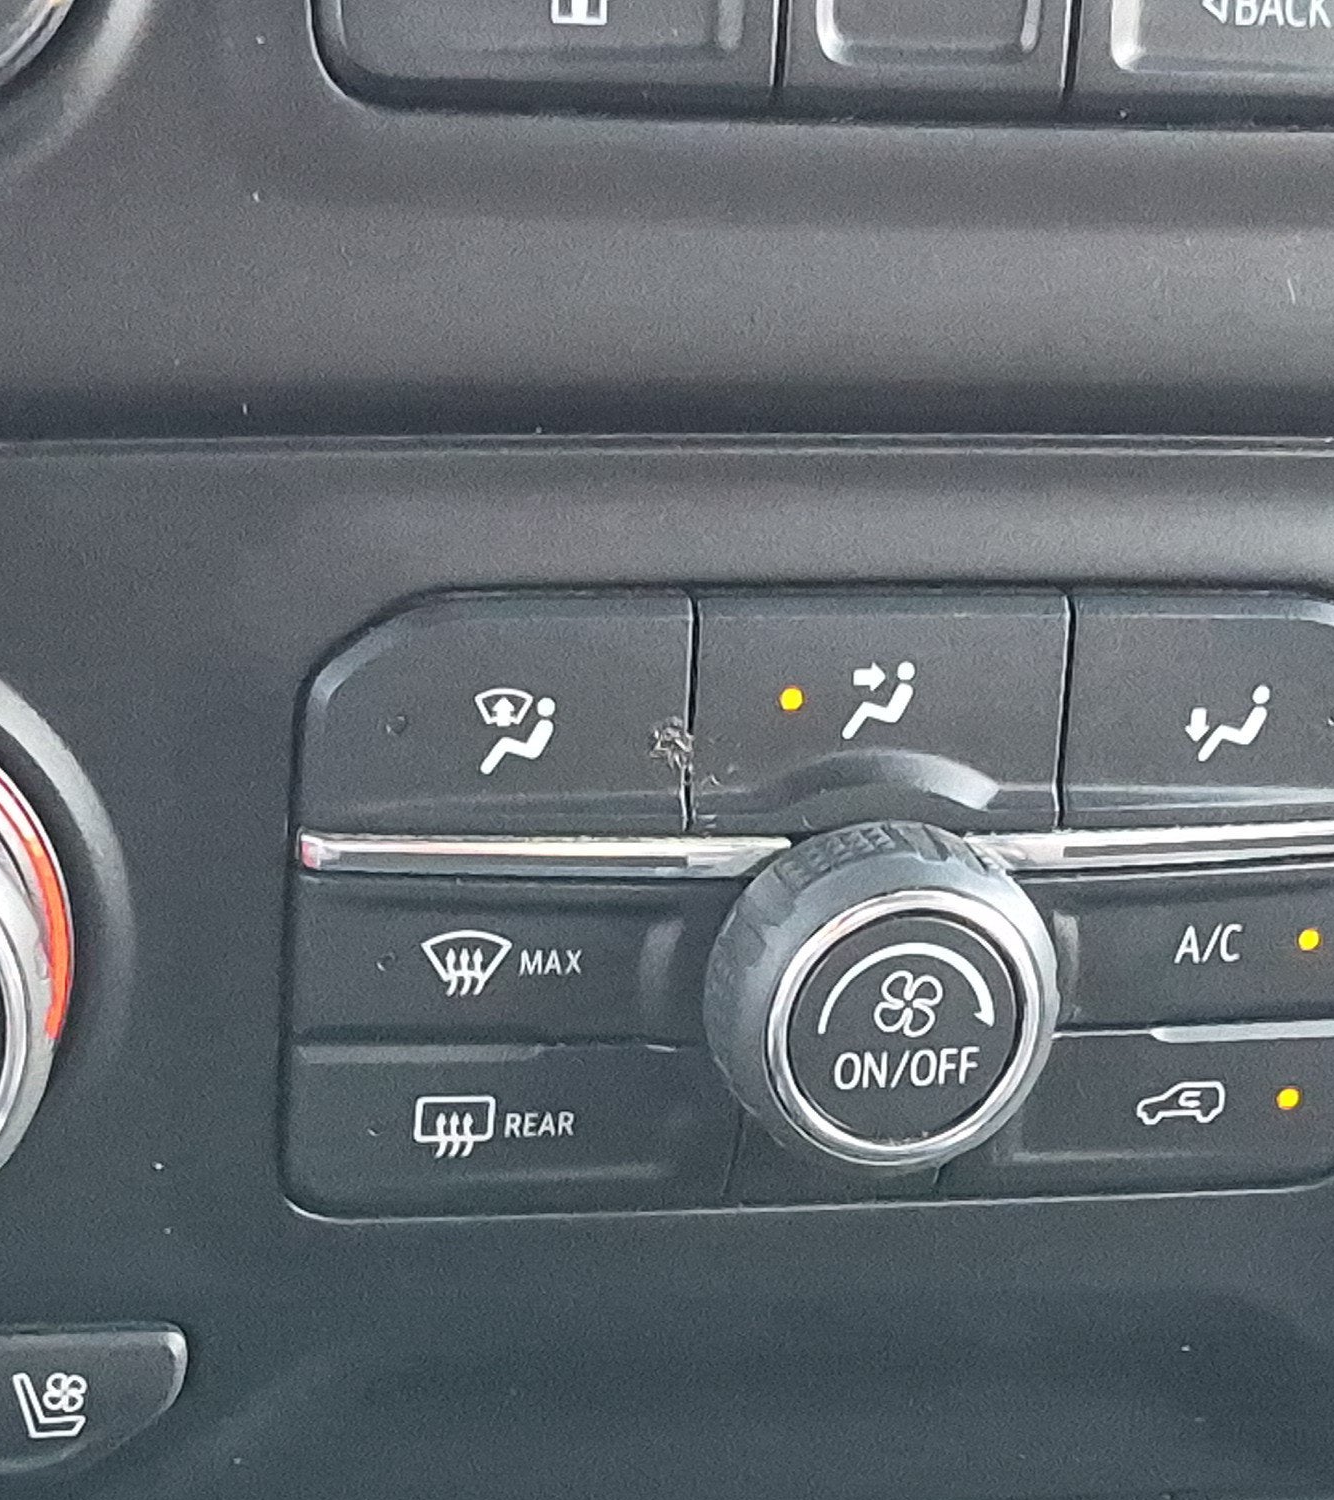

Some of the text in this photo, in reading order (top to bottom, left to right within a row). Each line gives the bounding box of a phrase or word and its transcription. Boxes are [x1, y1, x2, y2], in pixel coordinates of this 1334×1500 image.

[1235, 0, 1331, 28] BACK
[1174, 924, 1242, 965] A/C
[519, 948, 583, 976] MAX
[833, 1048, 980, 1092] ON/OFF
[504, 1111, 575, 1137] REAR
